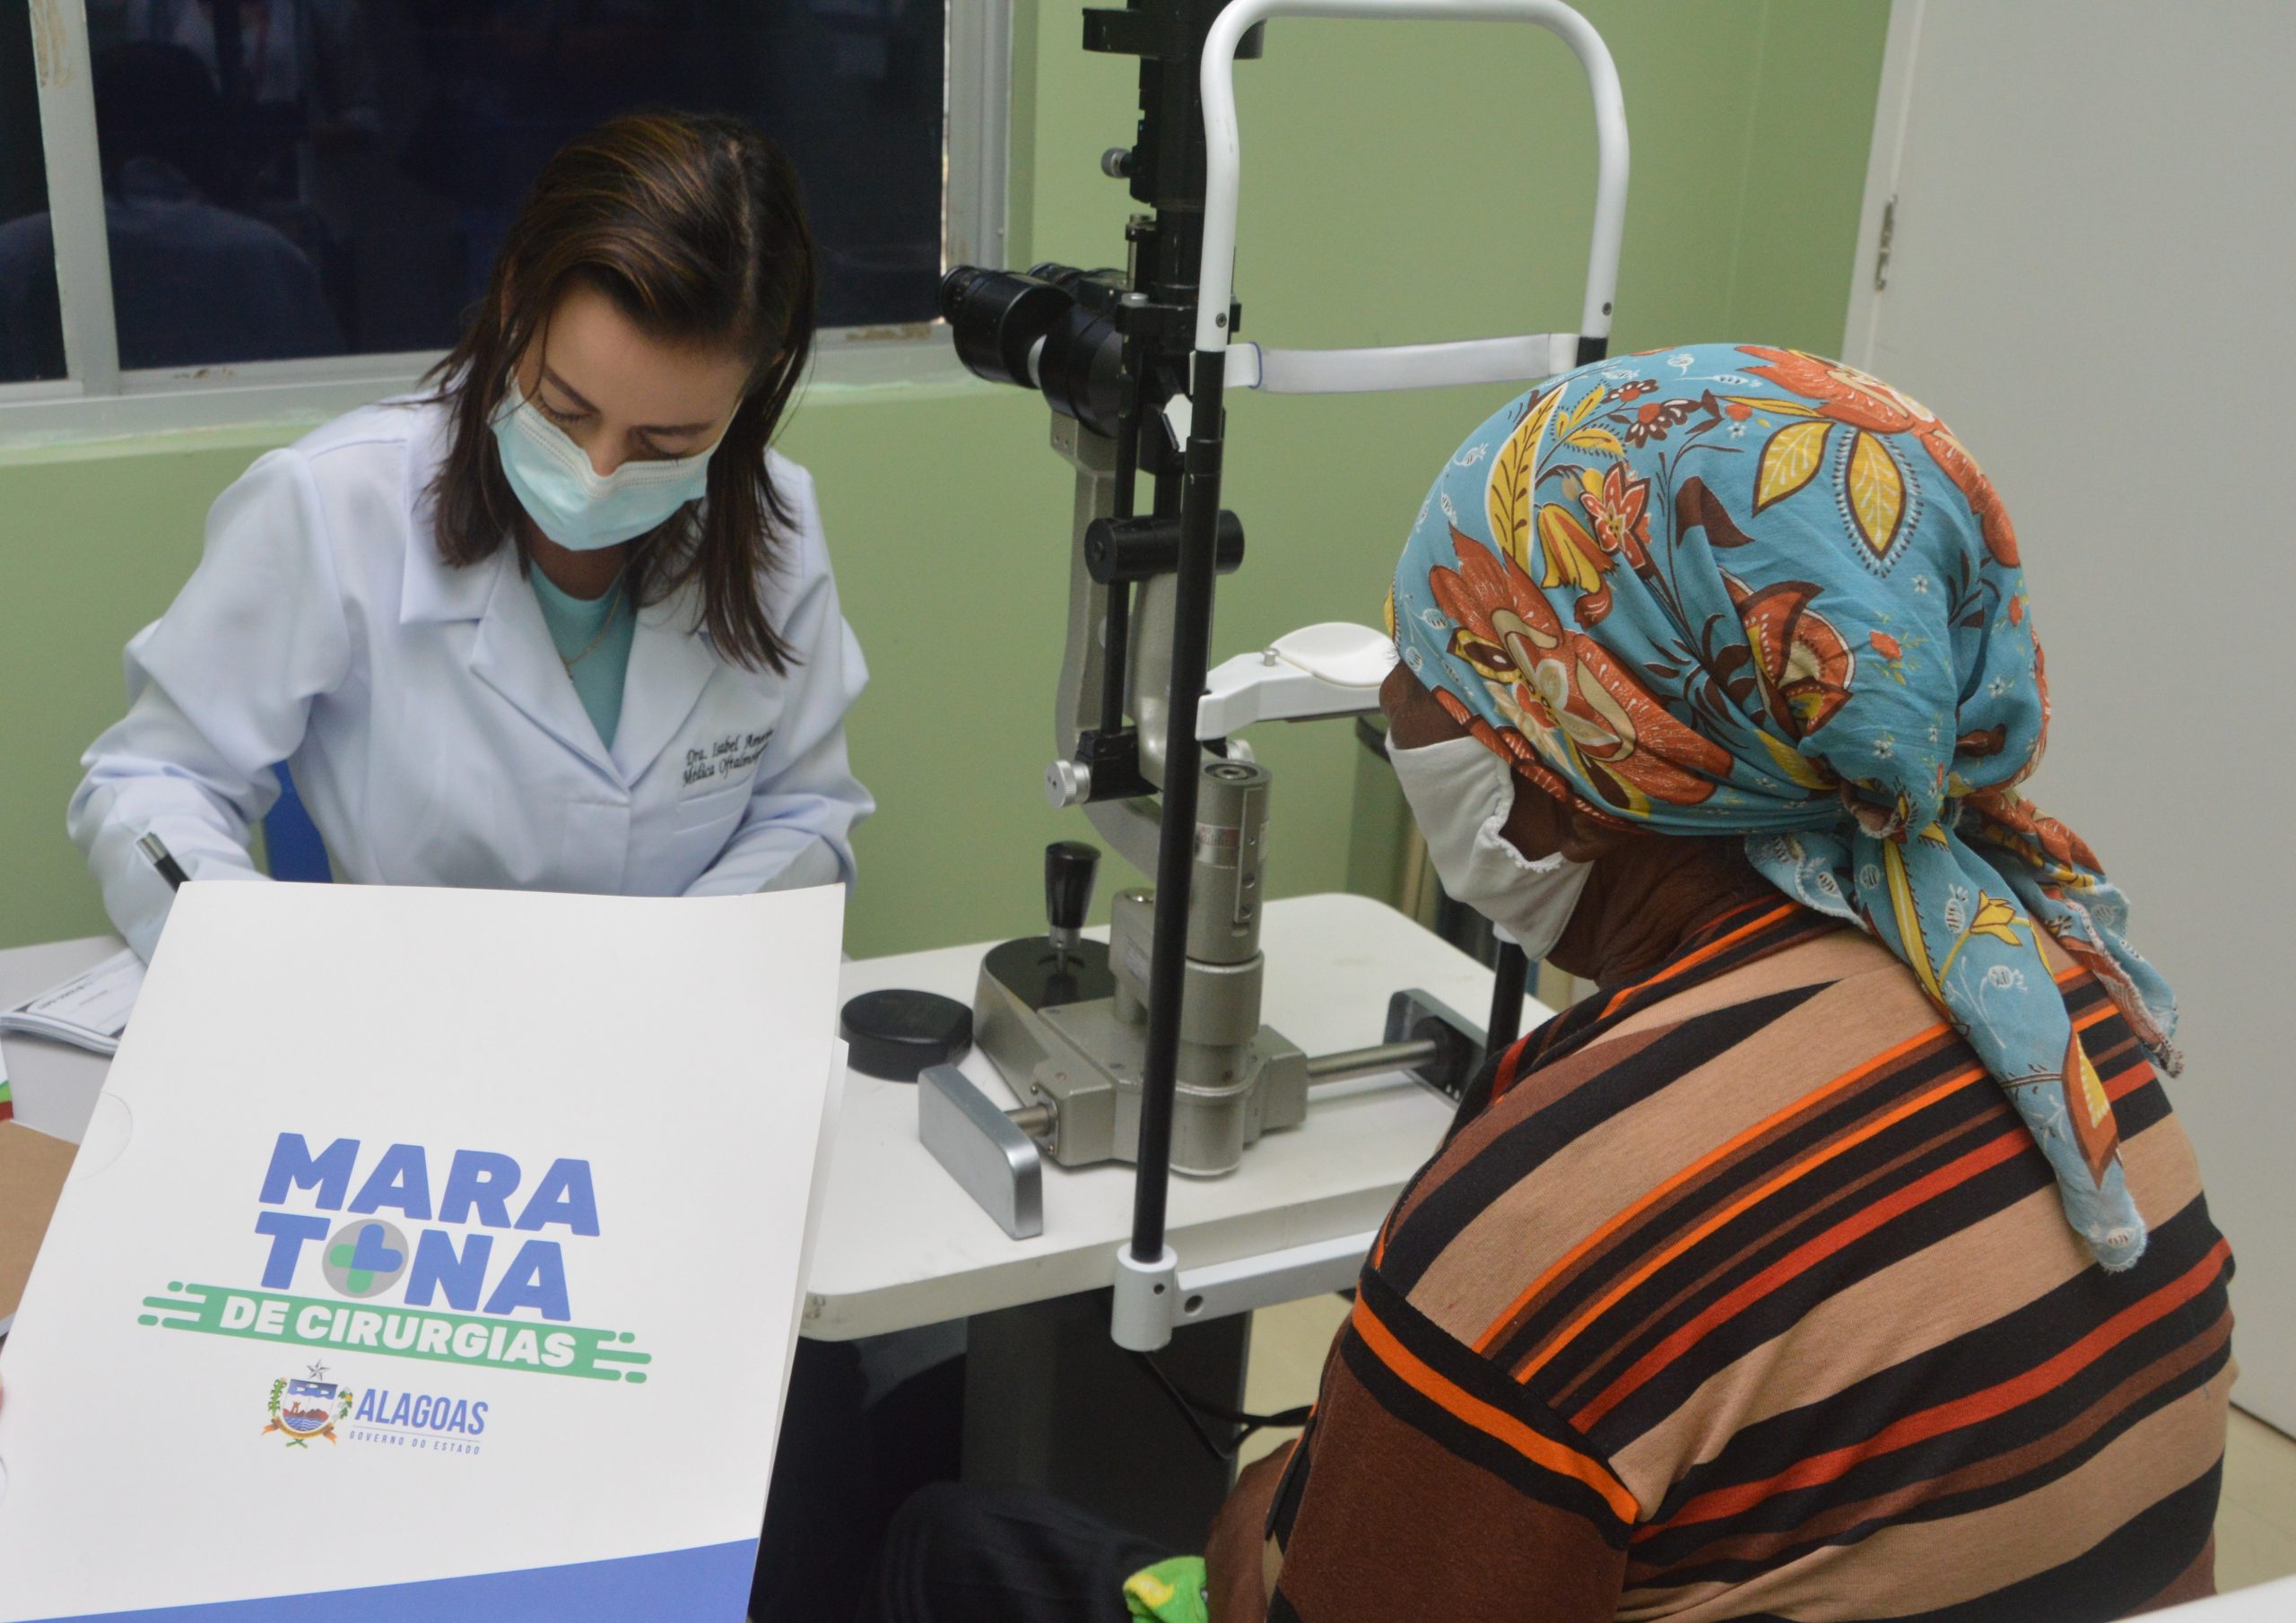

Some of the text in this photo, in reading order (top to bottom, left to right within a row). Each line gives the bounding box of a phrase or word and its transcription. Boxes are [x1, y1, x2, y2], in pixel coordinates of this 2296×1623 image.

[686, 749, 707, 766] Dra.
[712, 734, 740, 758] Isabel
[258, 1132, 601, 1237] MARA
[219, 1296, 576, 1367] DE CIRURGIAS
[355, 1388, 489, 1436] ALAGOAS
[349, 1430, 481, 1455] GOVERNO DO ESTADO
